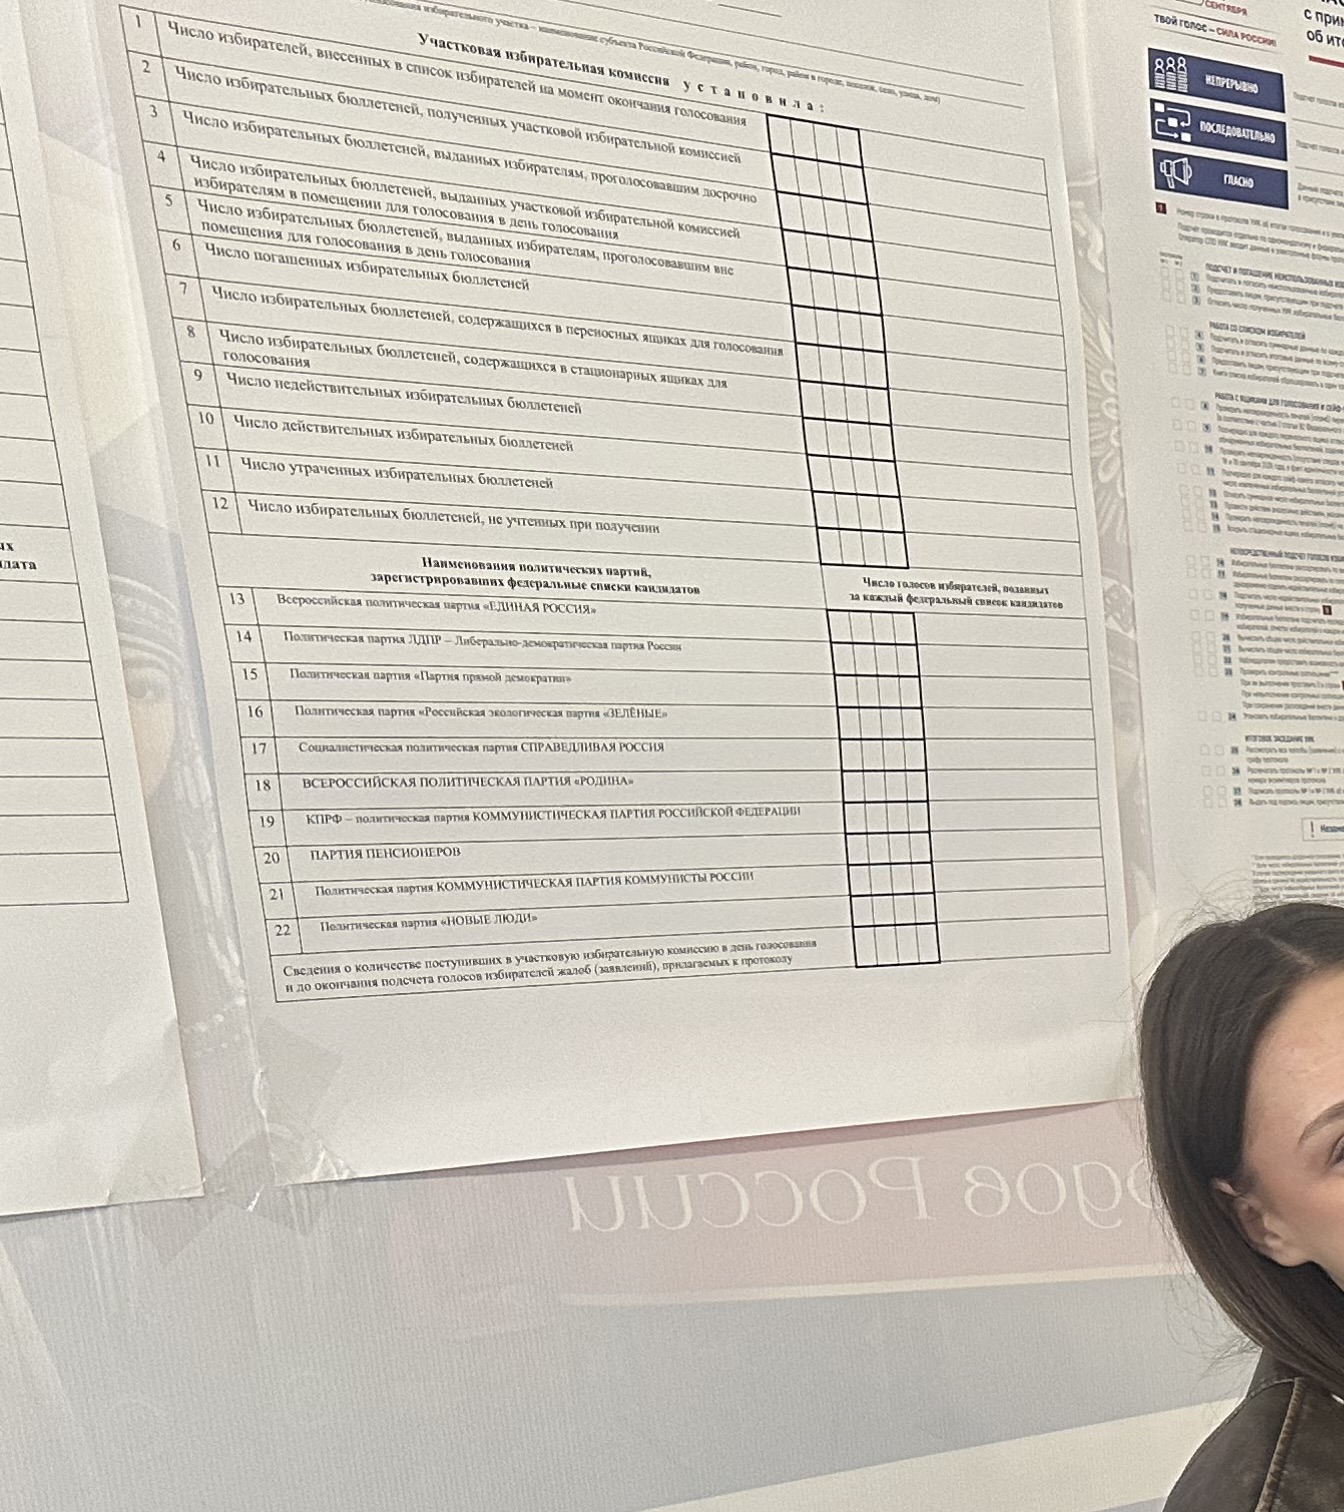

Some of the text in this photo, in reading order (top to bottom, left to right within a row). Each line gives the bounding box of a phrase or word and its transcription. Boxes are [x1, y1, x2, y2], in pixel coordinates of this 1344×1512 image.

[1205, 1, 1248, 16] СЕНТЯБРЯ
[1303, 9, 1313, 21] с
[1154, 13, 1178, 26] ТВОЙ
[1178, 18, 1208, 33] ГОЛОС
[1216, 27, 1240, 40] СИЛА
[1306, 29, 1324, 44] об
[135, 14, 747, 127] 1 Число избирателей, внесенных в список избирателей на момент окончания голосования
[416, 32, 502, 58] Участковая
[505, 49, 605, 76] избирательная
[608, 67, 670, 87] комиссия
[1205, 74, 1259, 94] НЕПРЕРЫВНО
[1199, 121, 1276, 144] ПОСЛЕДОВАТЕЛЬНО
[1223, 173, 1255, 189] ГЛАСНО
[172, 238, 530, 291] 6 Число погашенных избирательных бюллетеней
[193, 368, 582, 415] 9 Число недействительных избирательных бюллетеней
[212, 496, 661, 535] 12 Число избирательных бюллетеней, не учтенных при получении
[229, 592, 597, 615] 13 Всероссийская политическая партия «ЕДИНАЯ РОССИЯ»
[252, 739, 666, 755] 17 Социалистическая политическая партия СПРАВЕДЛИВАЯ РОССИЯ
[255, 773, 634, 792] 18 ВСЕРОССИЙСКАЯ ПОЛИТИЧЕСКАЯ ПАРТИЯ «РОДИНА»
[262, 846, 462, 865] 20 ПАРТИЯ ПЕНСИОНЕРОВ
[268, 868, 754, 901] 21 Политическая партия КОММУНИСТИЧЕСКАЯ ПАРТИЯ КОММУНИСТЫ РОССИИ
[273, 912, 538, 937] 22 Политическая партия «НОВЫЕ ЛЮДИ»
